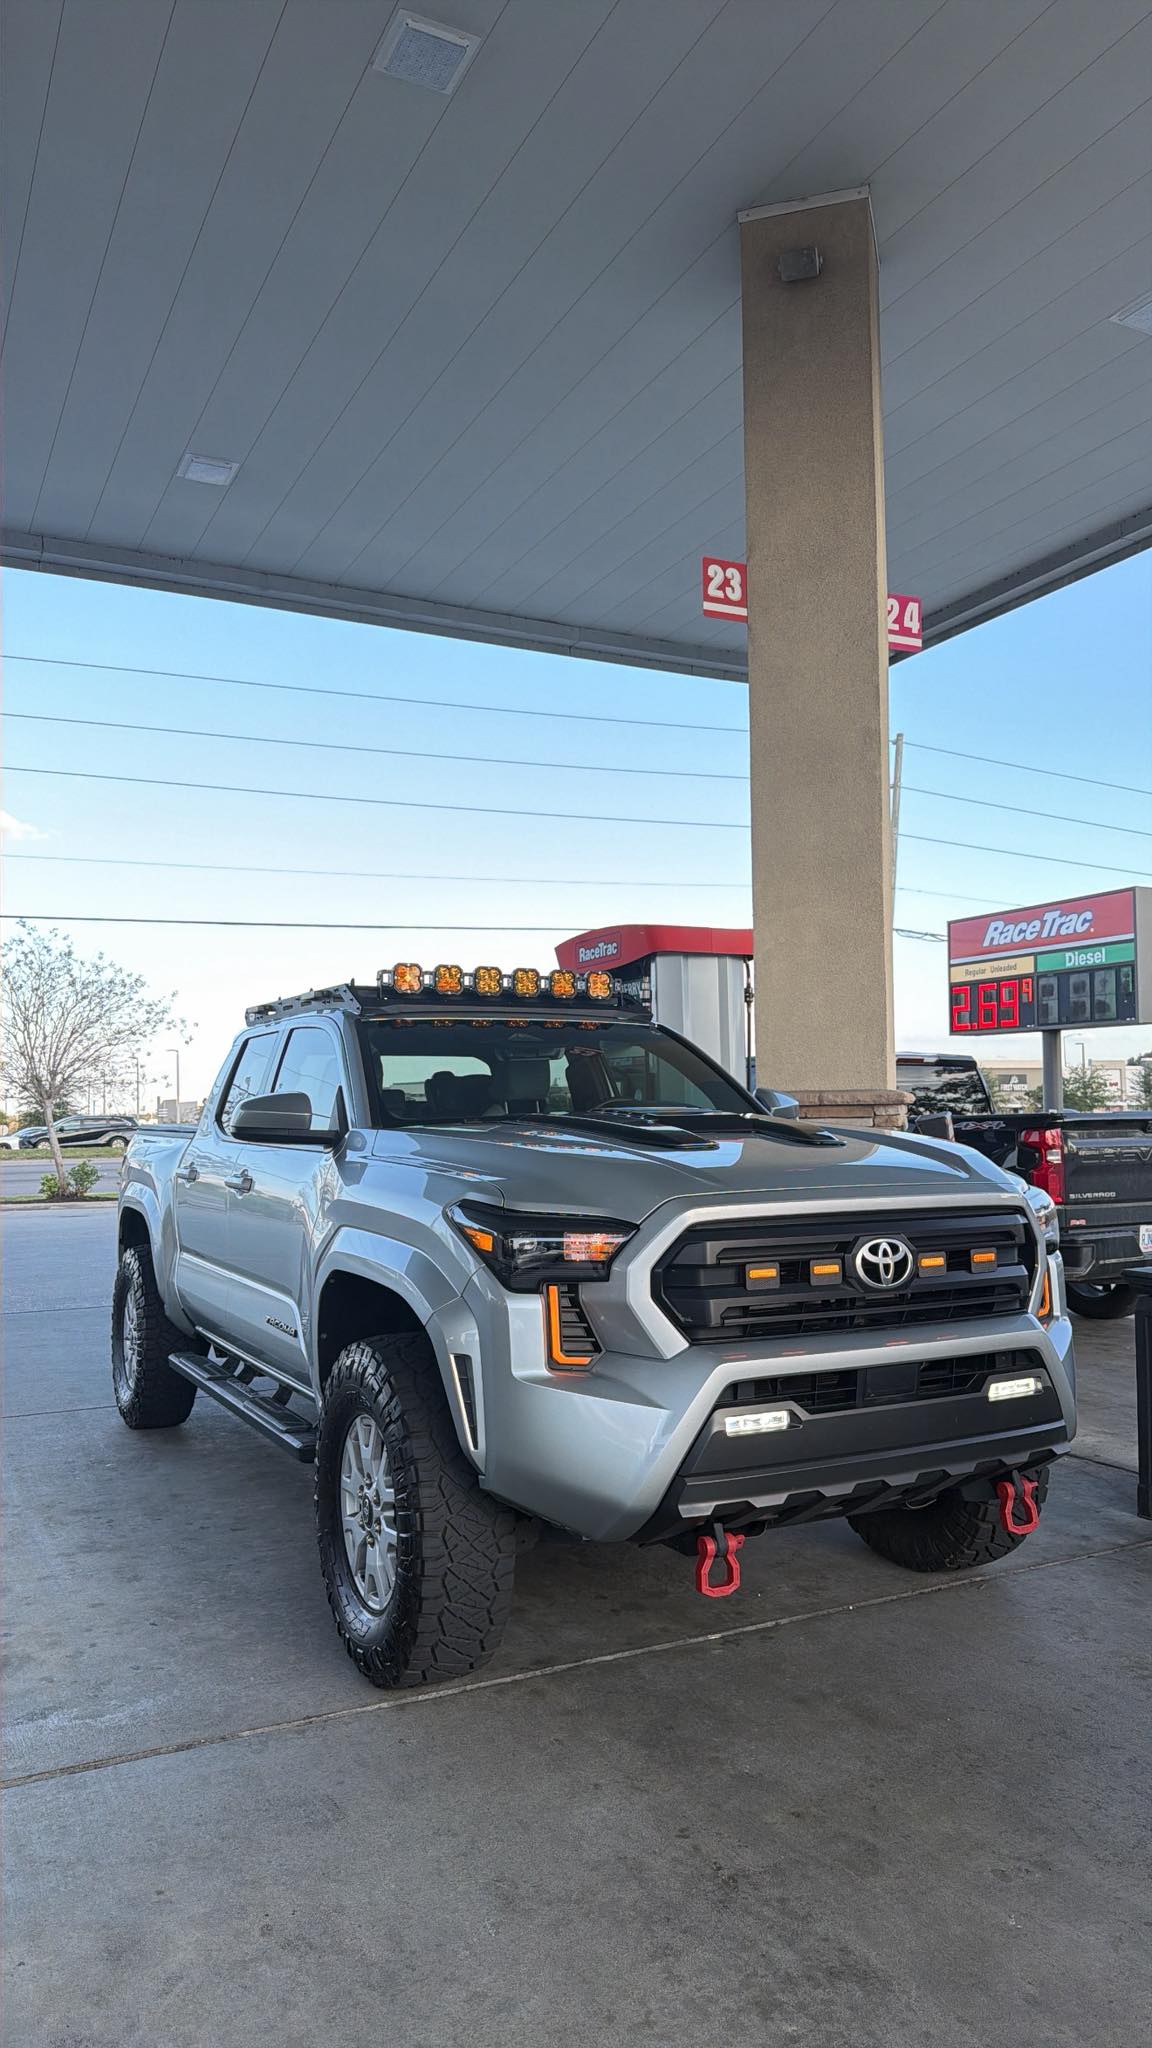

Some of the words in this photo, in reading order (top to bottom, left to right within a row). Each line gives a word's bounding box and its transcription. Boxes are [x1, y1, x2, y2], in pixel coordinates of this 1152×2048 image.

[707, 564, 742, 601] 23
[888, 597, 920, 634] 24
[982, 909, 1093, 947] RaceTrac
[579, 942, 618, 963] RaceTrac
[1065, 948, 1106, 967] Diesel
[964, 967, 987, 977] Regular
[990, 963, 1017, 974] Unleaded
[265, 1314, 297, 1338] TACOMA
